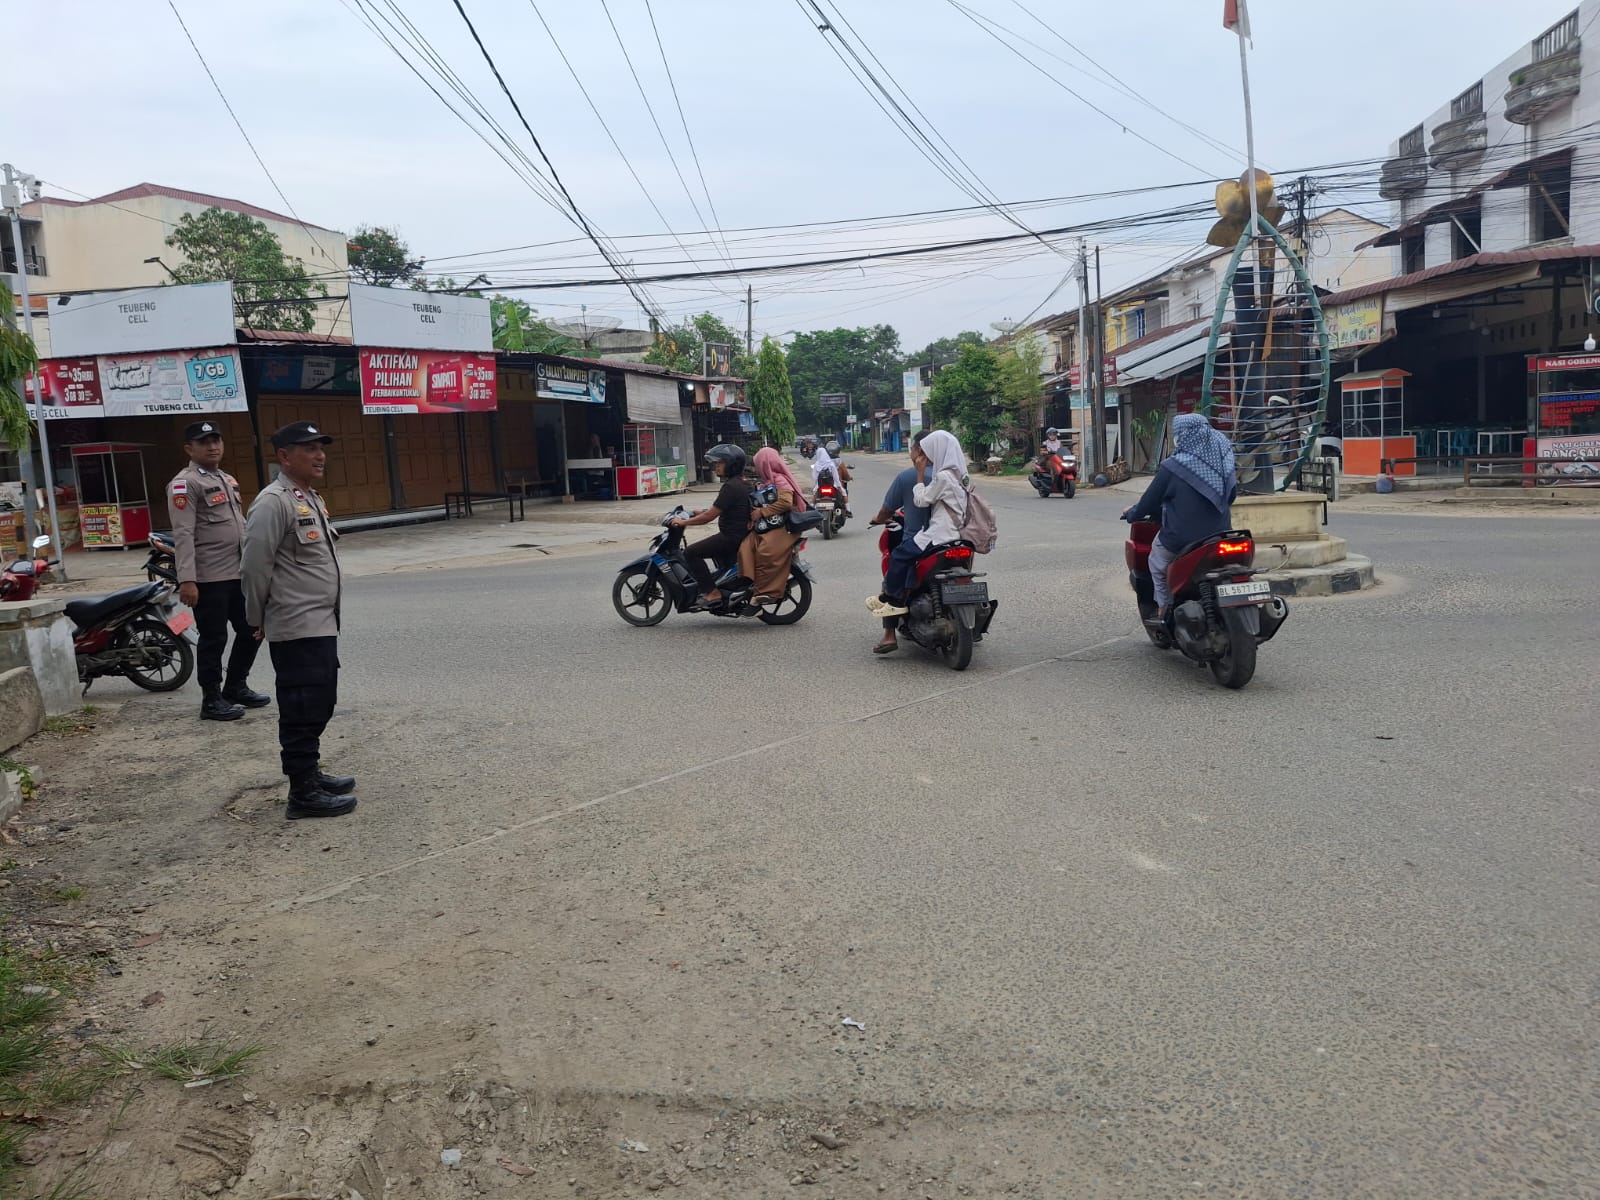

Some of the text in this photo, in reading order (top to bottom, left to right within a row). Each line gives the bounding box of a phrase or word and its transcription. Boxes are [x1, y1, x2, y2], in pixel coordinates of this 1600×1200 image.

[118, 301, 156, 314] TEUBENG
[412, 303, 441, 314] TEUBENG
[128, 315, 148, 324] CELL
[420, 314, 435, 324] CELL
[369, 353, 418, 369] AKTIFKAN
[1545, 359, 1566, 367] NASI
[205, 362, 226, 378] GB
[563, 366, 588, 382] COMPUTER
[374, 372, 413, 387] PILIHAN
[431, 371, 457, 389] SIMPATI
[144, 402, 204, 412] TEUBENG CELL
[49, 408, 69, 418] CELL
[1219, 587, 1230, 595] BL
